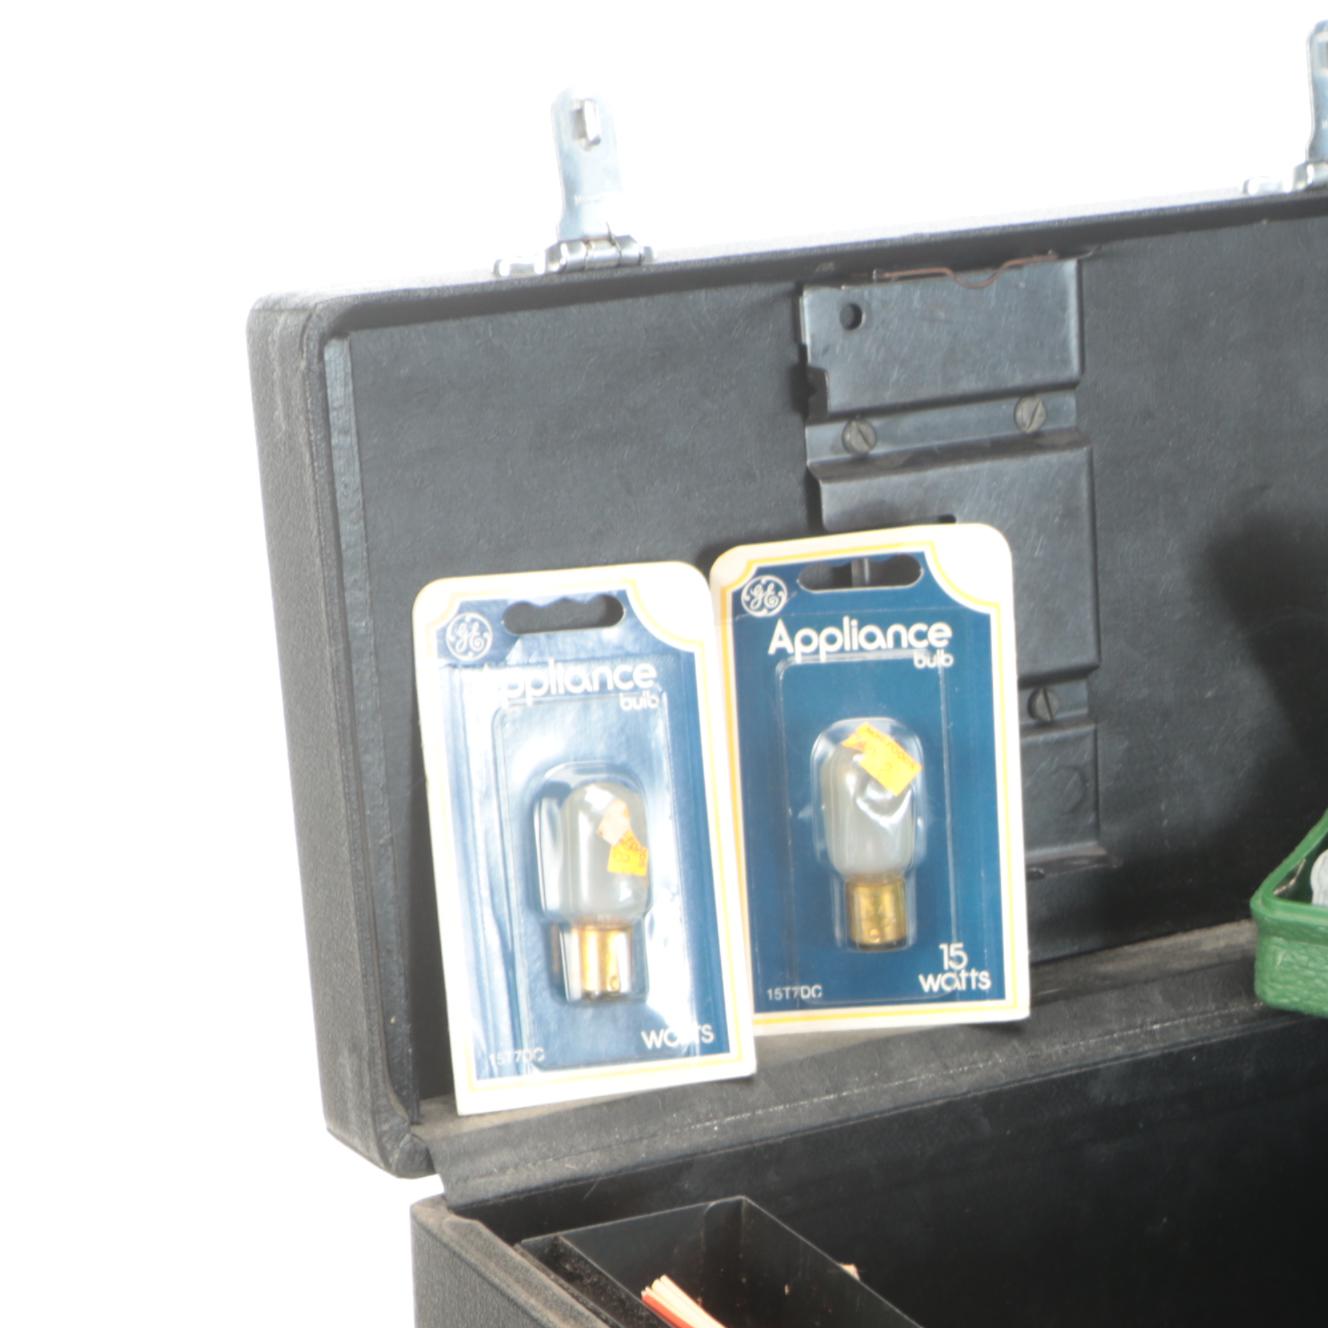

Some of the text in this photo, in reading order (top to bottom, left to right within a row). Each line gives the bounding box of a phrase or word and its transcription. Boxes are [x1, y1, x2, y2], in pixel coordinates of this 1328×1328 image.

[768, 615, 953, 664] Appliance
[912, 650, 955, 669] bulb
[619, 691, 660, 712] bulb
[938, 943, 969, 970] 15
[918, 970, 993, 993] watts
